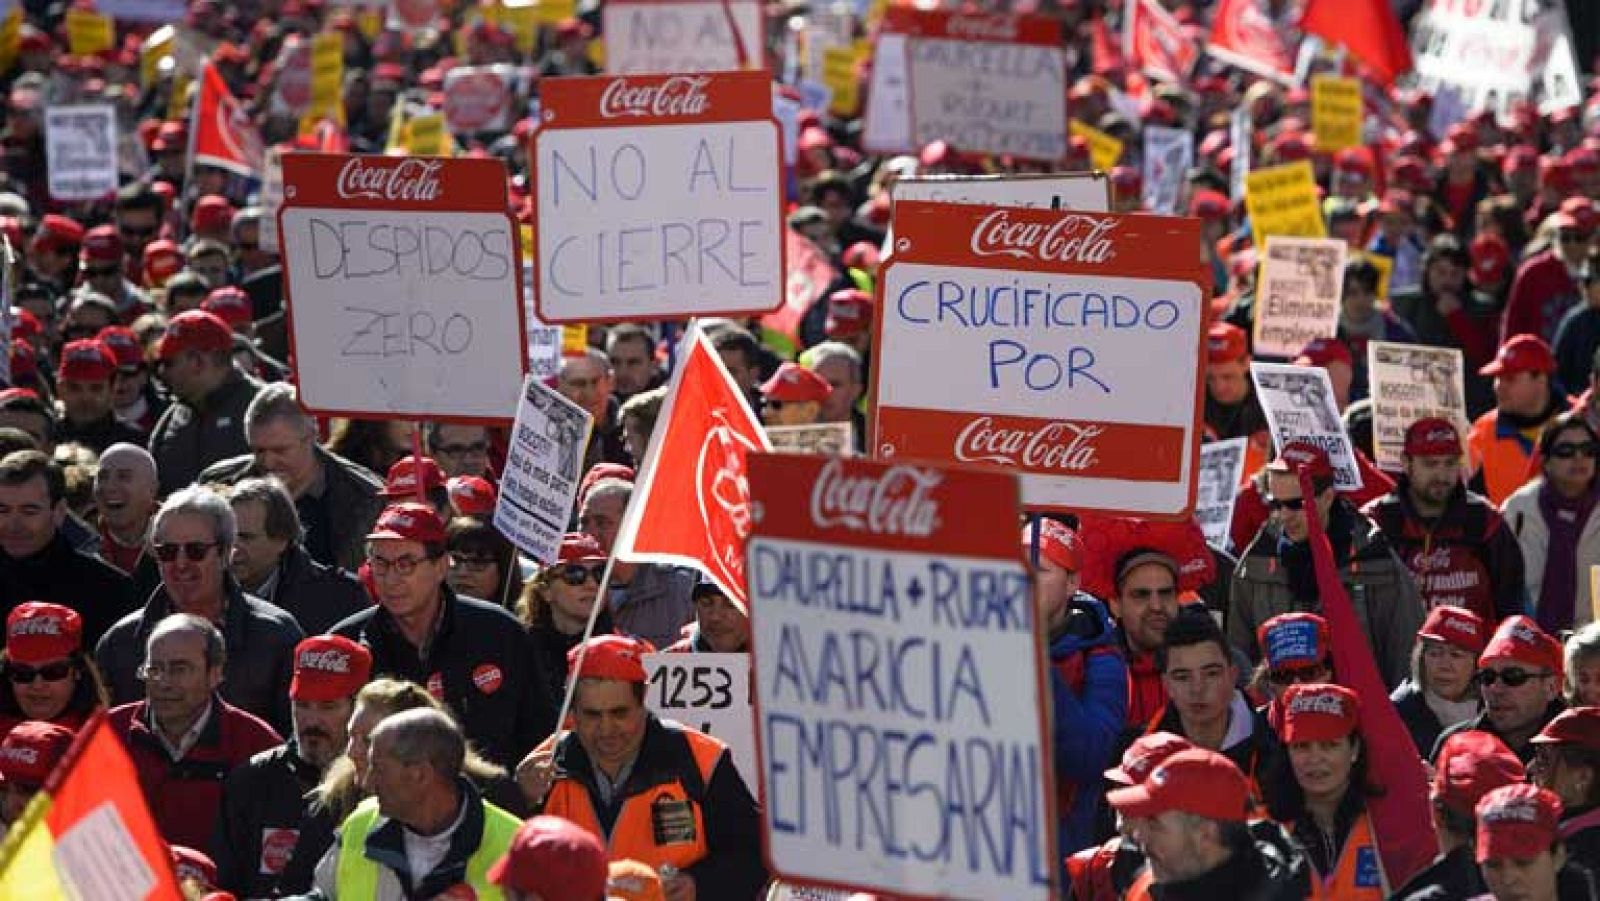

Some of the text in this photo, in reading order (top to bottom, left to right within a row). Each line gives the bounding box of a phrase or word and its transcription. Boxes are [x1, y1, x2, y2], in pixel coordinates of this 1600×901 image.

[600, 77, 713, 119] Coca-Cola
[336, 157, 443, 201] Coca-Cola
[550, 136, 768, 207] NO AL
[309, 217, 509, 283] DESPIDOS
[549, 219, 771, 297] CIERRE
[970, 209, 1120, 264] Coca-Cola
[341, 306, 474, 357] ZERO
[897, 278, 1181, 332] CRUCIFICADO
[988, 340, 1113, 394] POR
[953, 416, 1104, 471] Coca-Cola
[810, 455, 944, 538] Coca-Cola
[753, 542, 900, 623] DAURELLA
[650, 665, 733, 709] 1253
[771, 621, 992, 728] AVARICIA
[766, 711, 1050, 888] EMPRESARIAL
